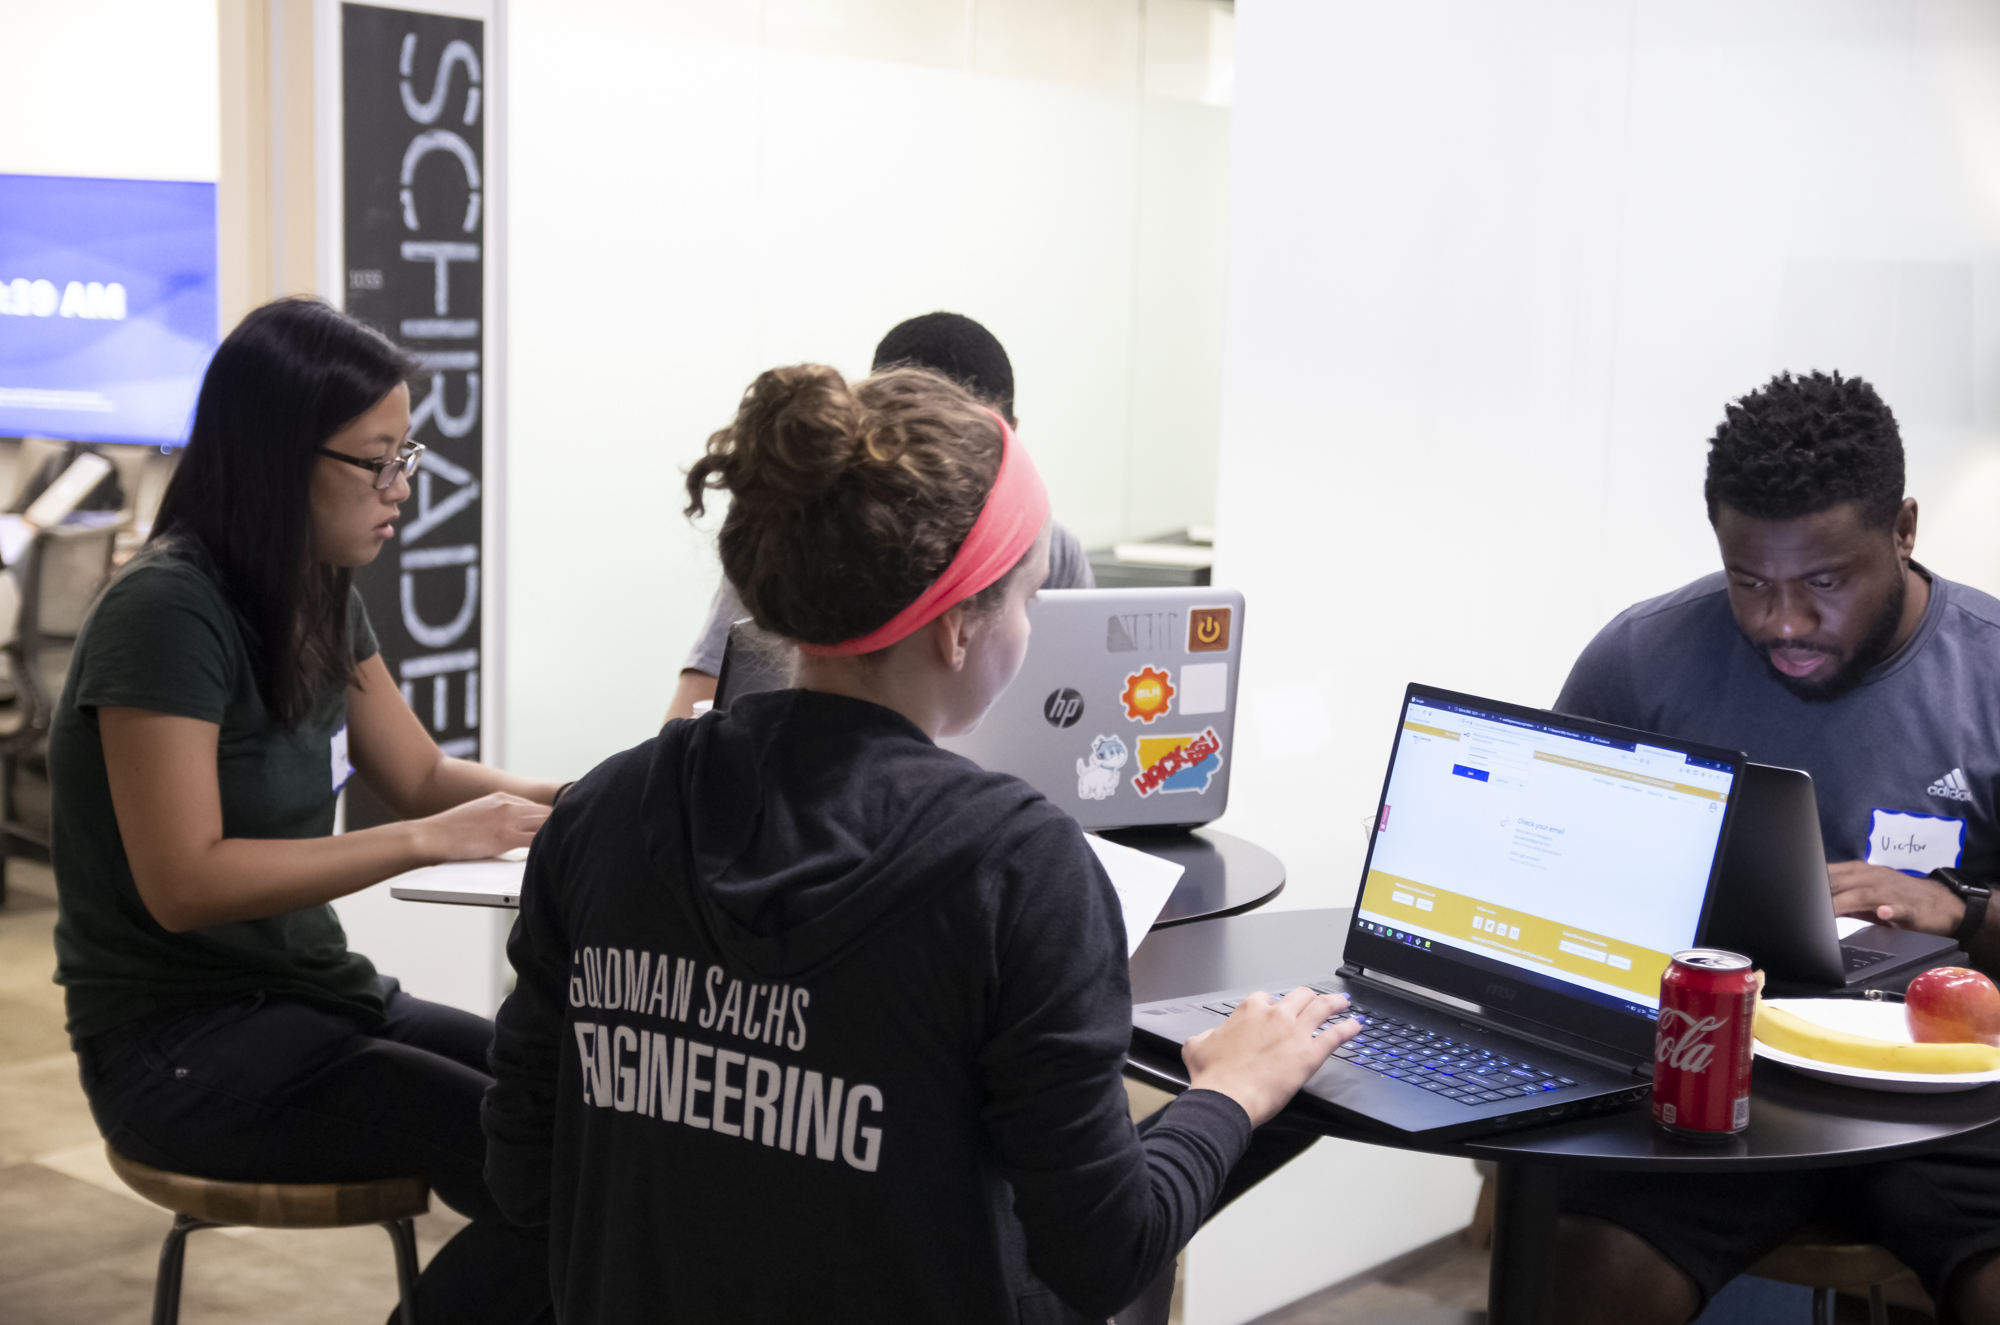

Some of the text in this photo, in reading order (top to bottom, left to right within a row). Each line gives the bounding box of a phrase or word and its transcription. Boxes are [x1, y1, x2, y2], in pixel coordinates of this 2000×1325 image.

[60, 280, 126, 321] AM
[1048, 687, 1080, 729] hp
[1517, 817, 1566, 835] Check your email
[1881, 834, 1927, 854] Victor
[569, 946, 810, 1052] GOLDMAN SACHS
[574, 1021, 884, 1173] ENGINEERING
